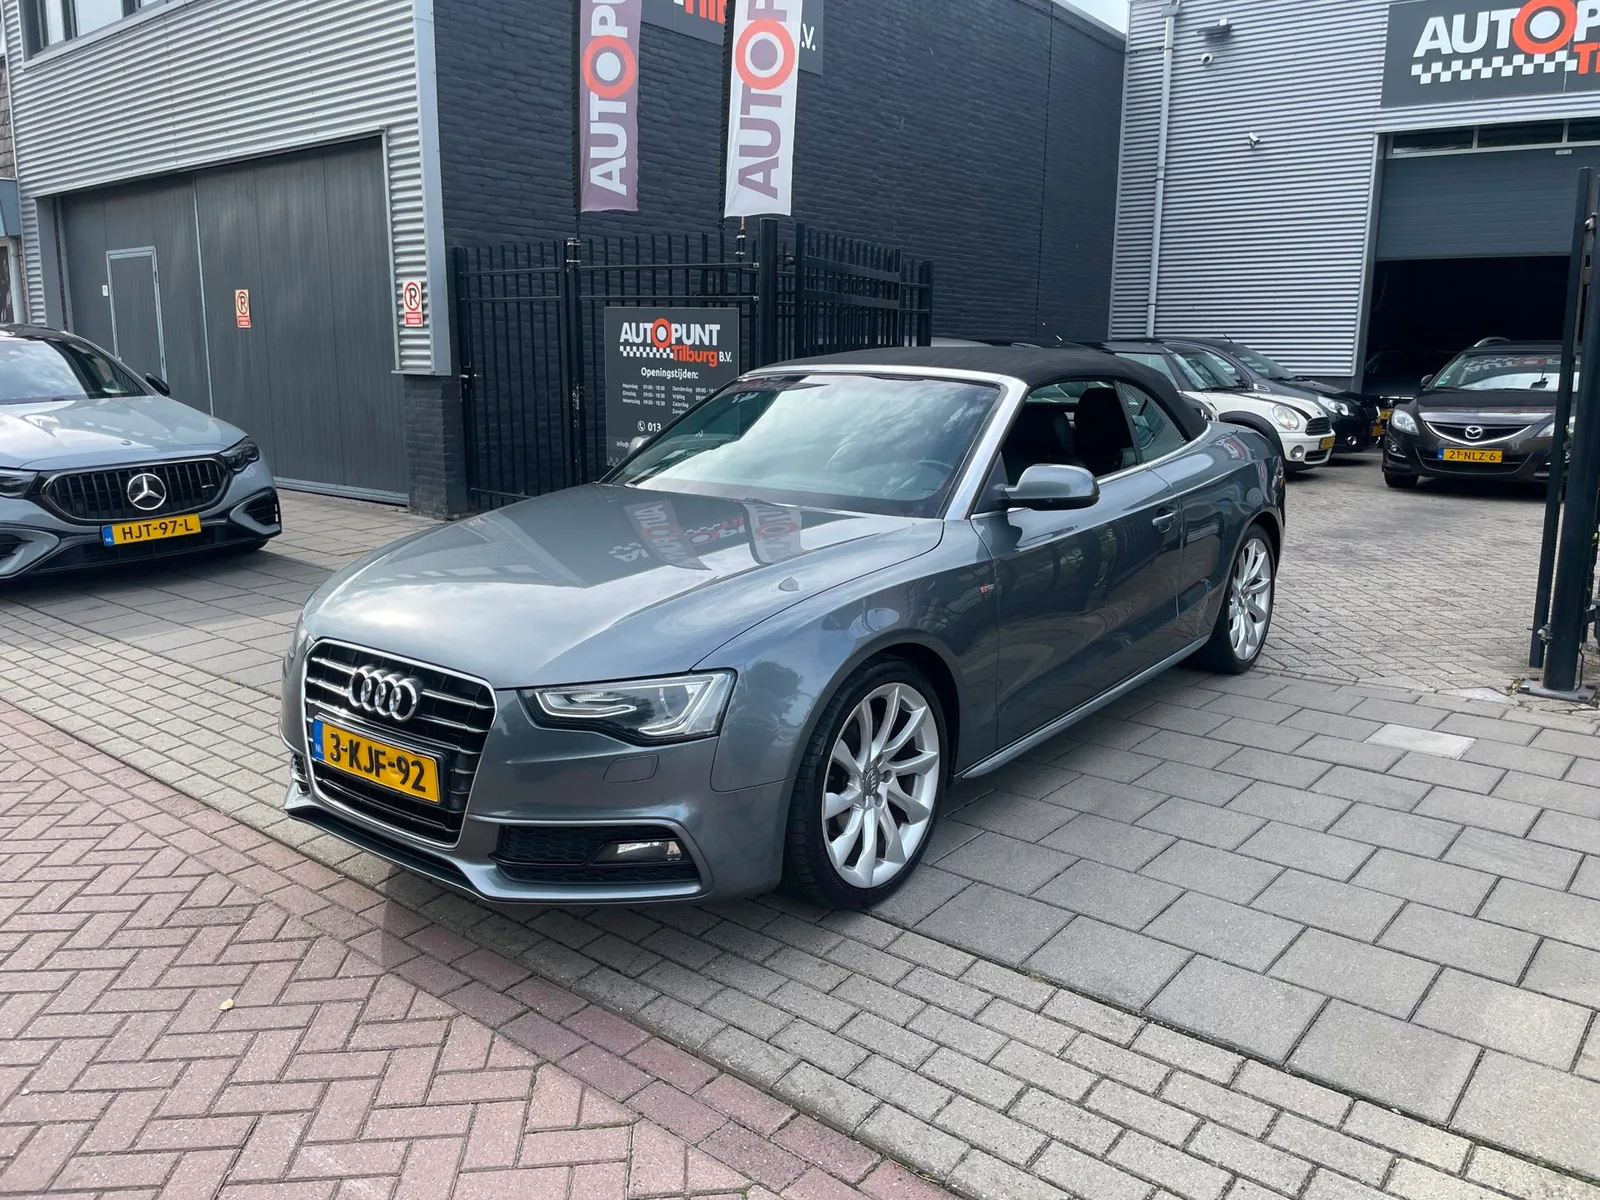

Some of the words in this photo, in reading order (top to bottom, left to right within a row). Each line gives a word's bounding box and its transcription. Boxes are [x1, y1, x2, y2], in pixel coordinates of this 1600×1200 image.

[1413, 0, 1600, 57] AUTOP
[583, 0, 637, 195] AUTOP
[620, 318, 720, 348] AUTOPUNT
[672, 345, 718, 367] Tilburg
[719, 351, 732, 362] B.V.
[641, 367, 699, 380] Openingstijden:
[647, 422, 661, 432] 013
[1449, 451, 1496, 461] 21-NLZ-6
[122, 520, 194, 541] HJT-97-L
[330, 732, 426, 792] 3-KJF-92
